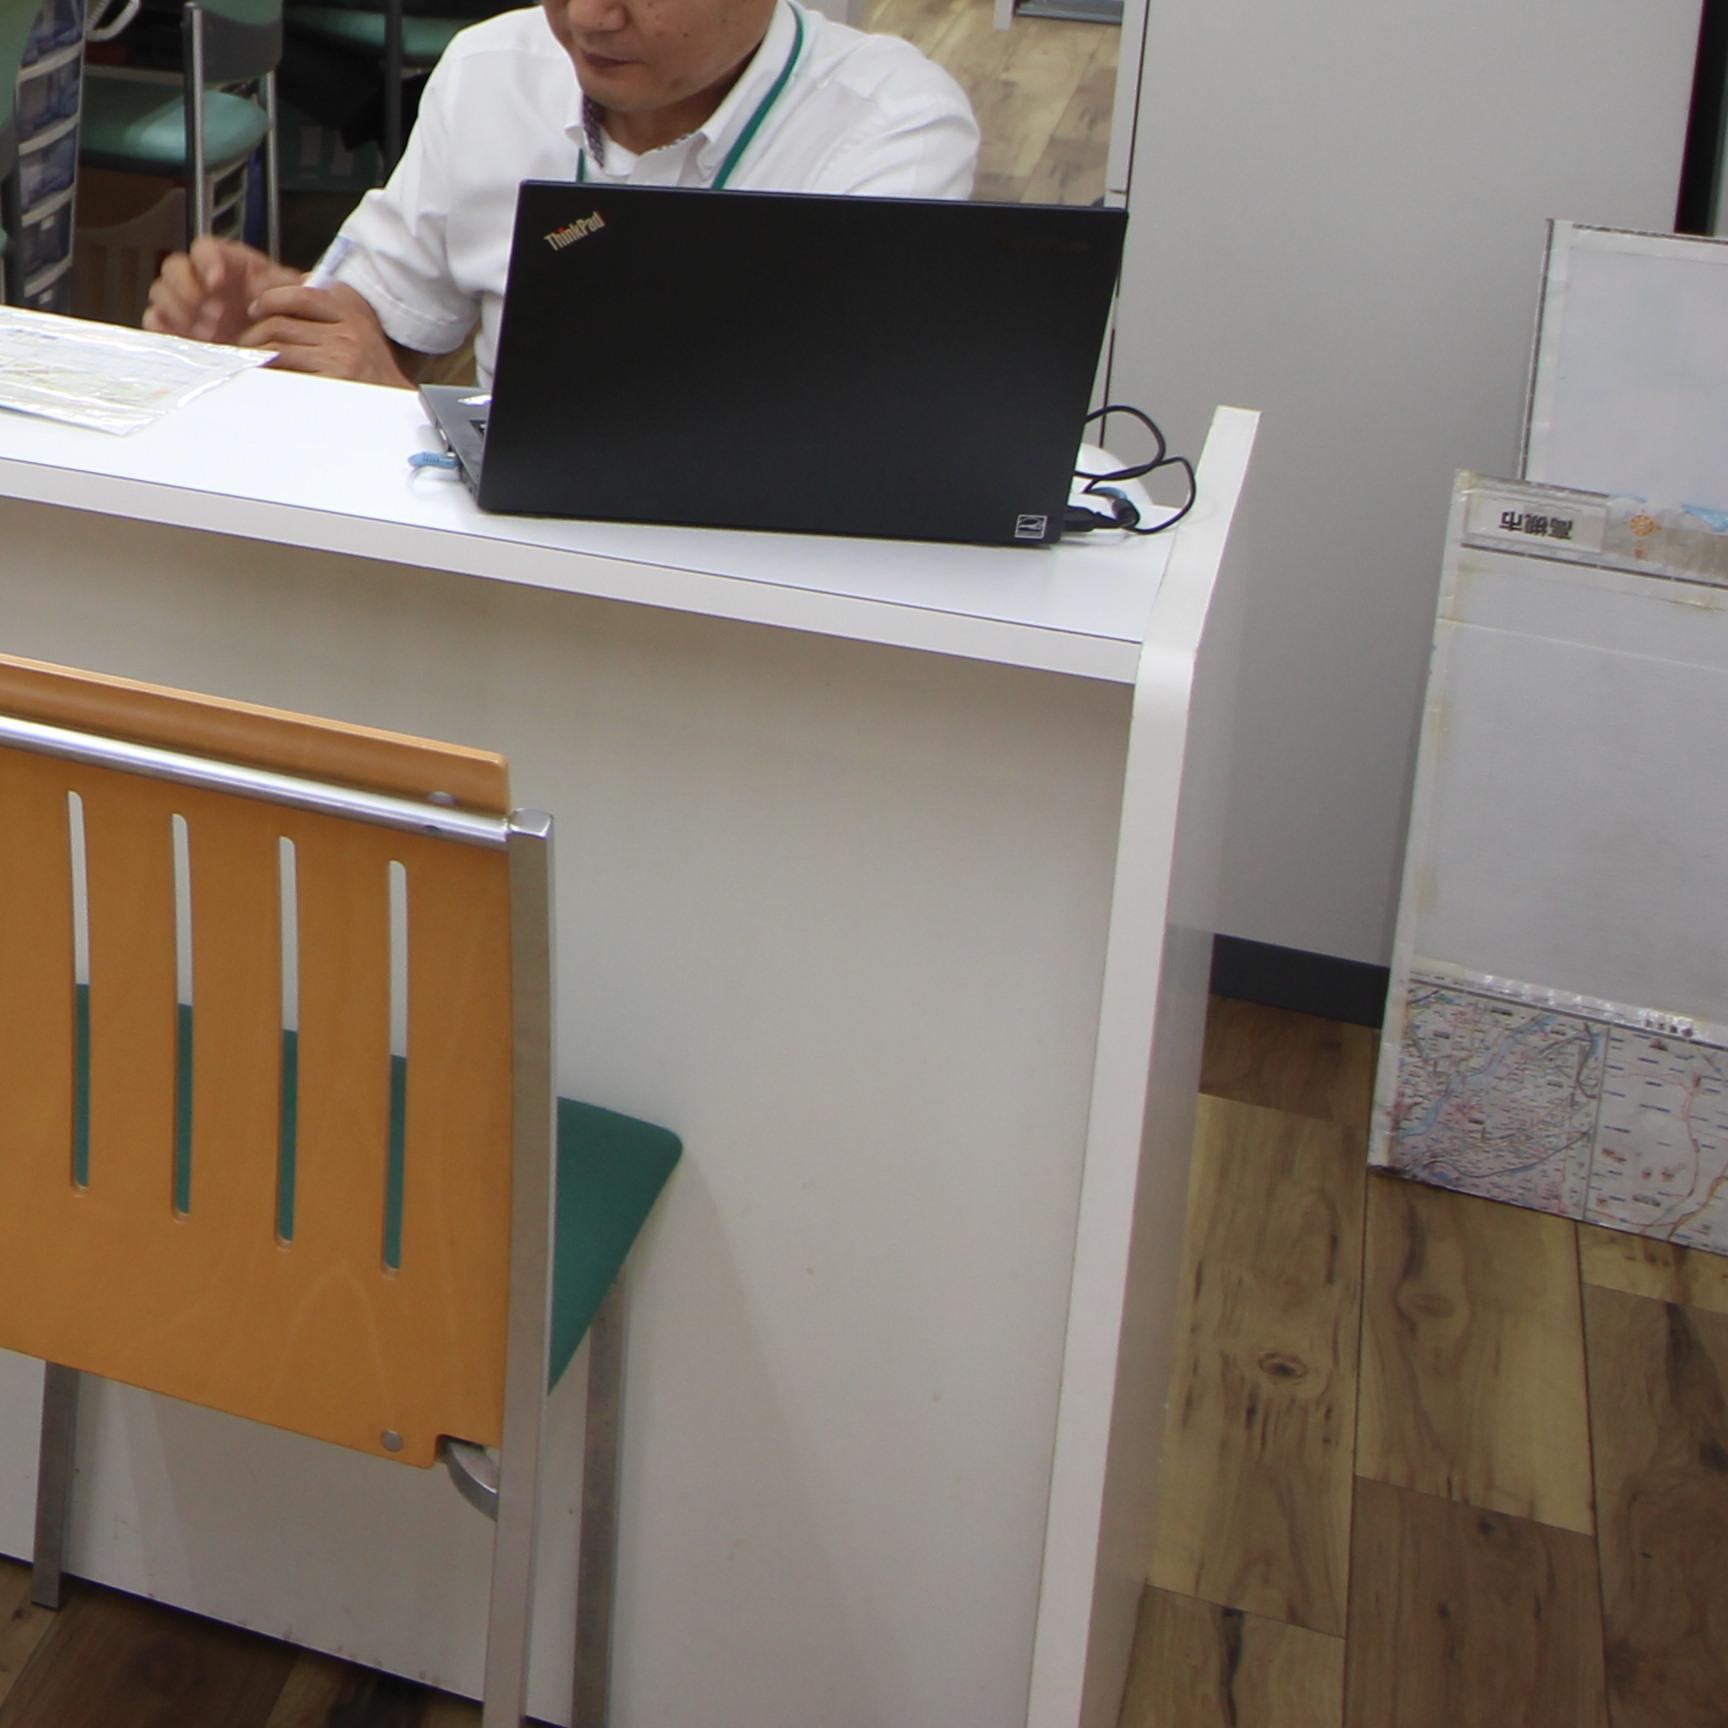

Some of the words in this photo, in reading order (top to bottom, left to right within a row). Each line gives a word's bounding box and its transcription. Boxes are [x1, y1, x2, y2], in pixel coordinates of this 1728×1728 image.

[543, 210, 605, 251] ThinkPad
[1498, 510, 1575, 541] 高槻市
